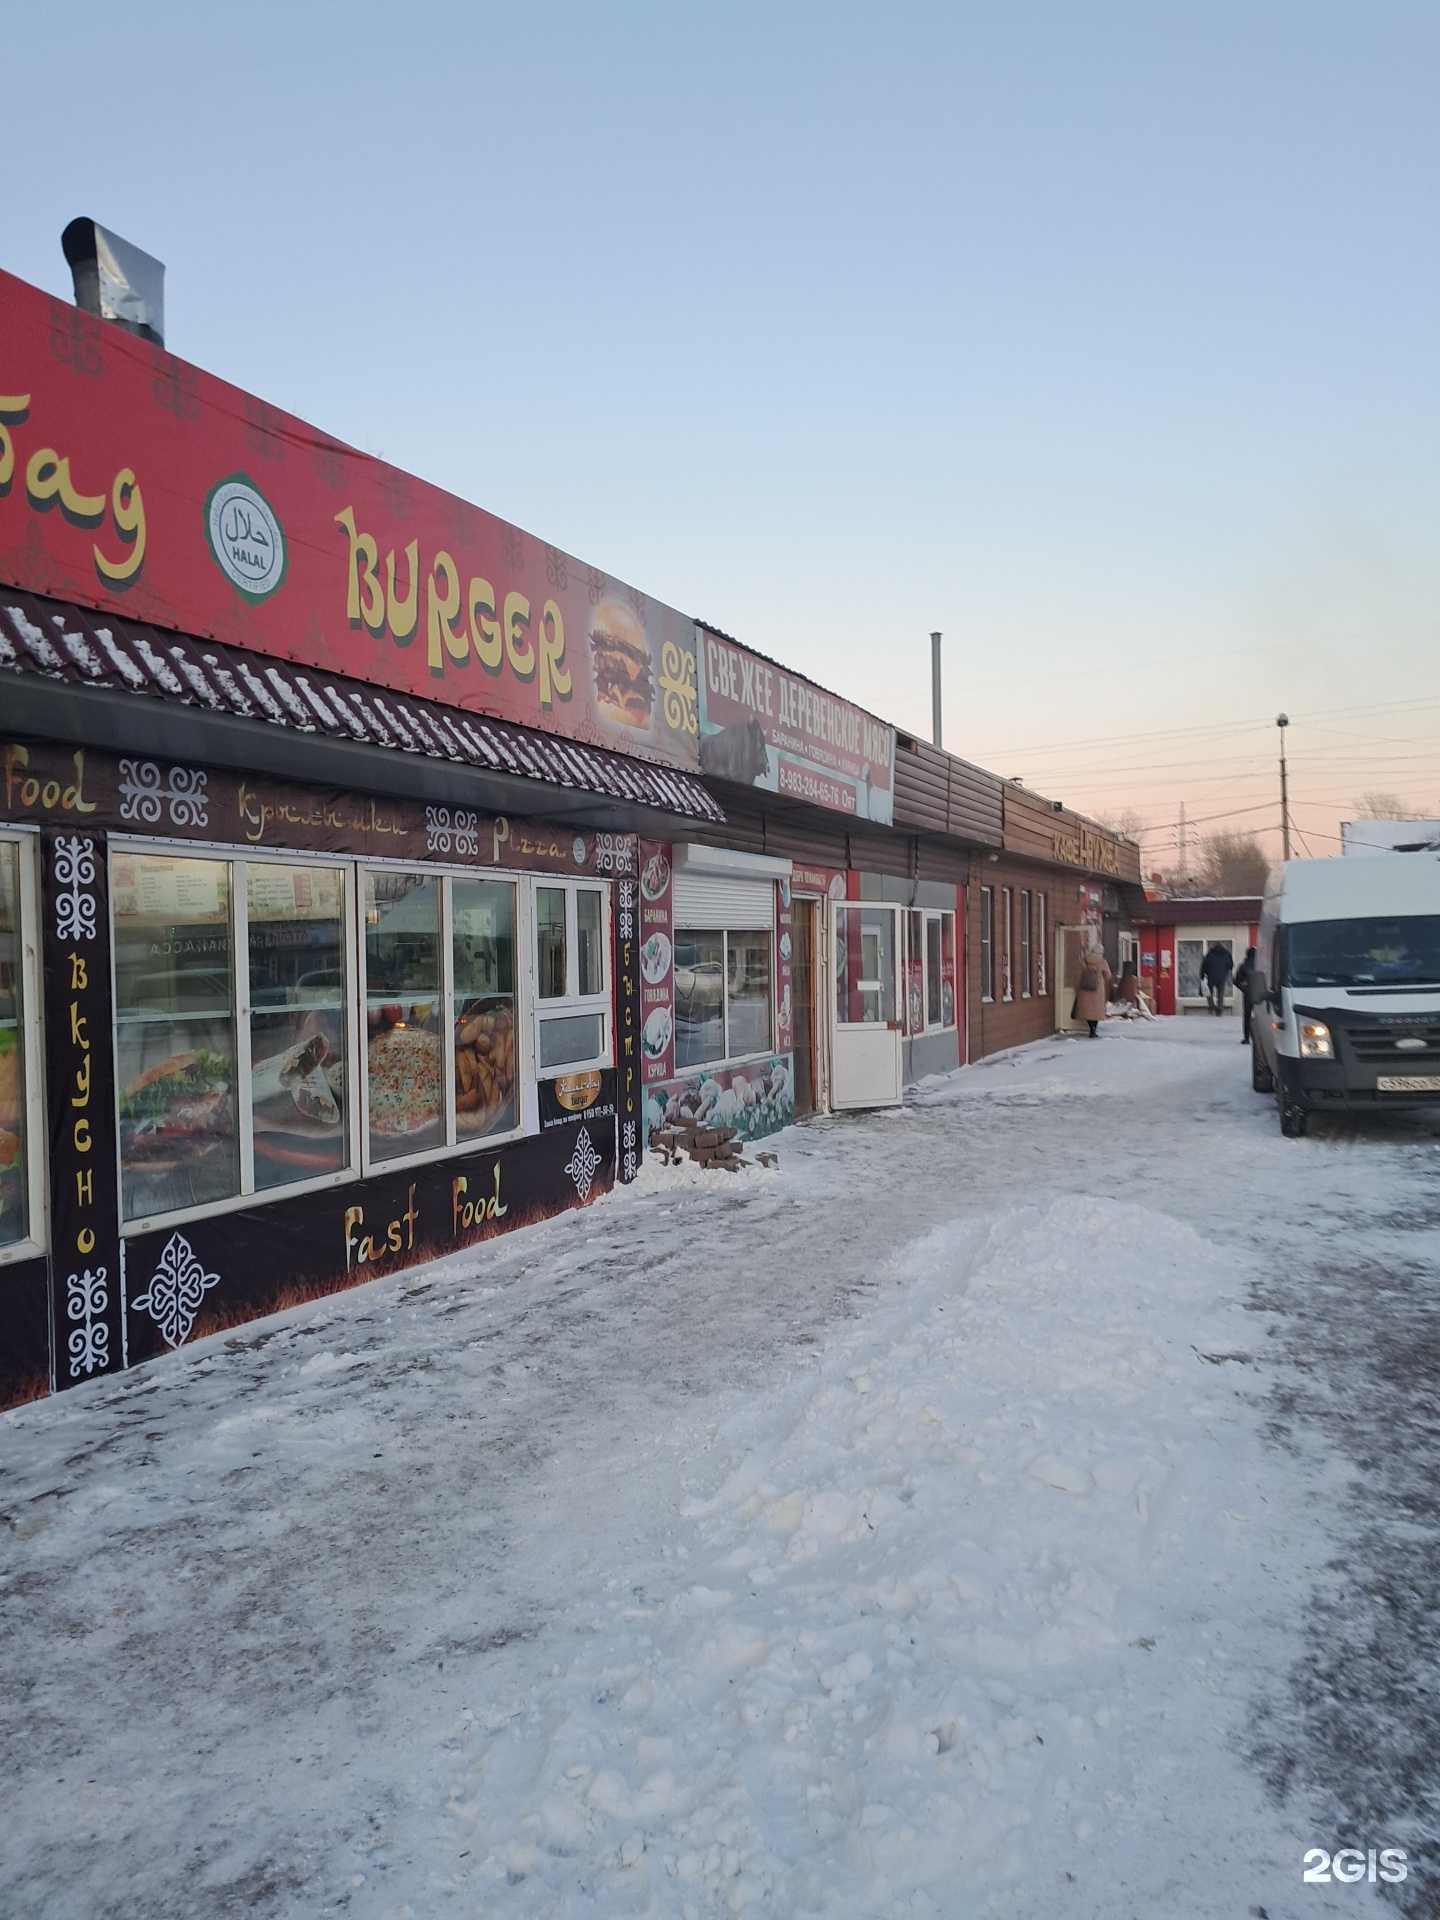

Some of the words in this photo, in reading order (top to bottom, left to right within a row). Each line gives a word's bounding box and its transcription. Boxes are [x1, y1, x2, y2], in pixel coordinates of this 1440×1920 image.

[225, 507, 270, 546] حلال
[232, 546, 267, 570] HALAL
[334, 505, 573, 705] BURGER
[707, 639, 773, 717] СВЕЖЕЕ
[779, 676, 861, 755] ДЕРЕВЕНСКОЕ
[3, 744, 96, 813] Food
[344, 1182, 419, 1273] Fast
[452, 1159, 509, 1237] Food
